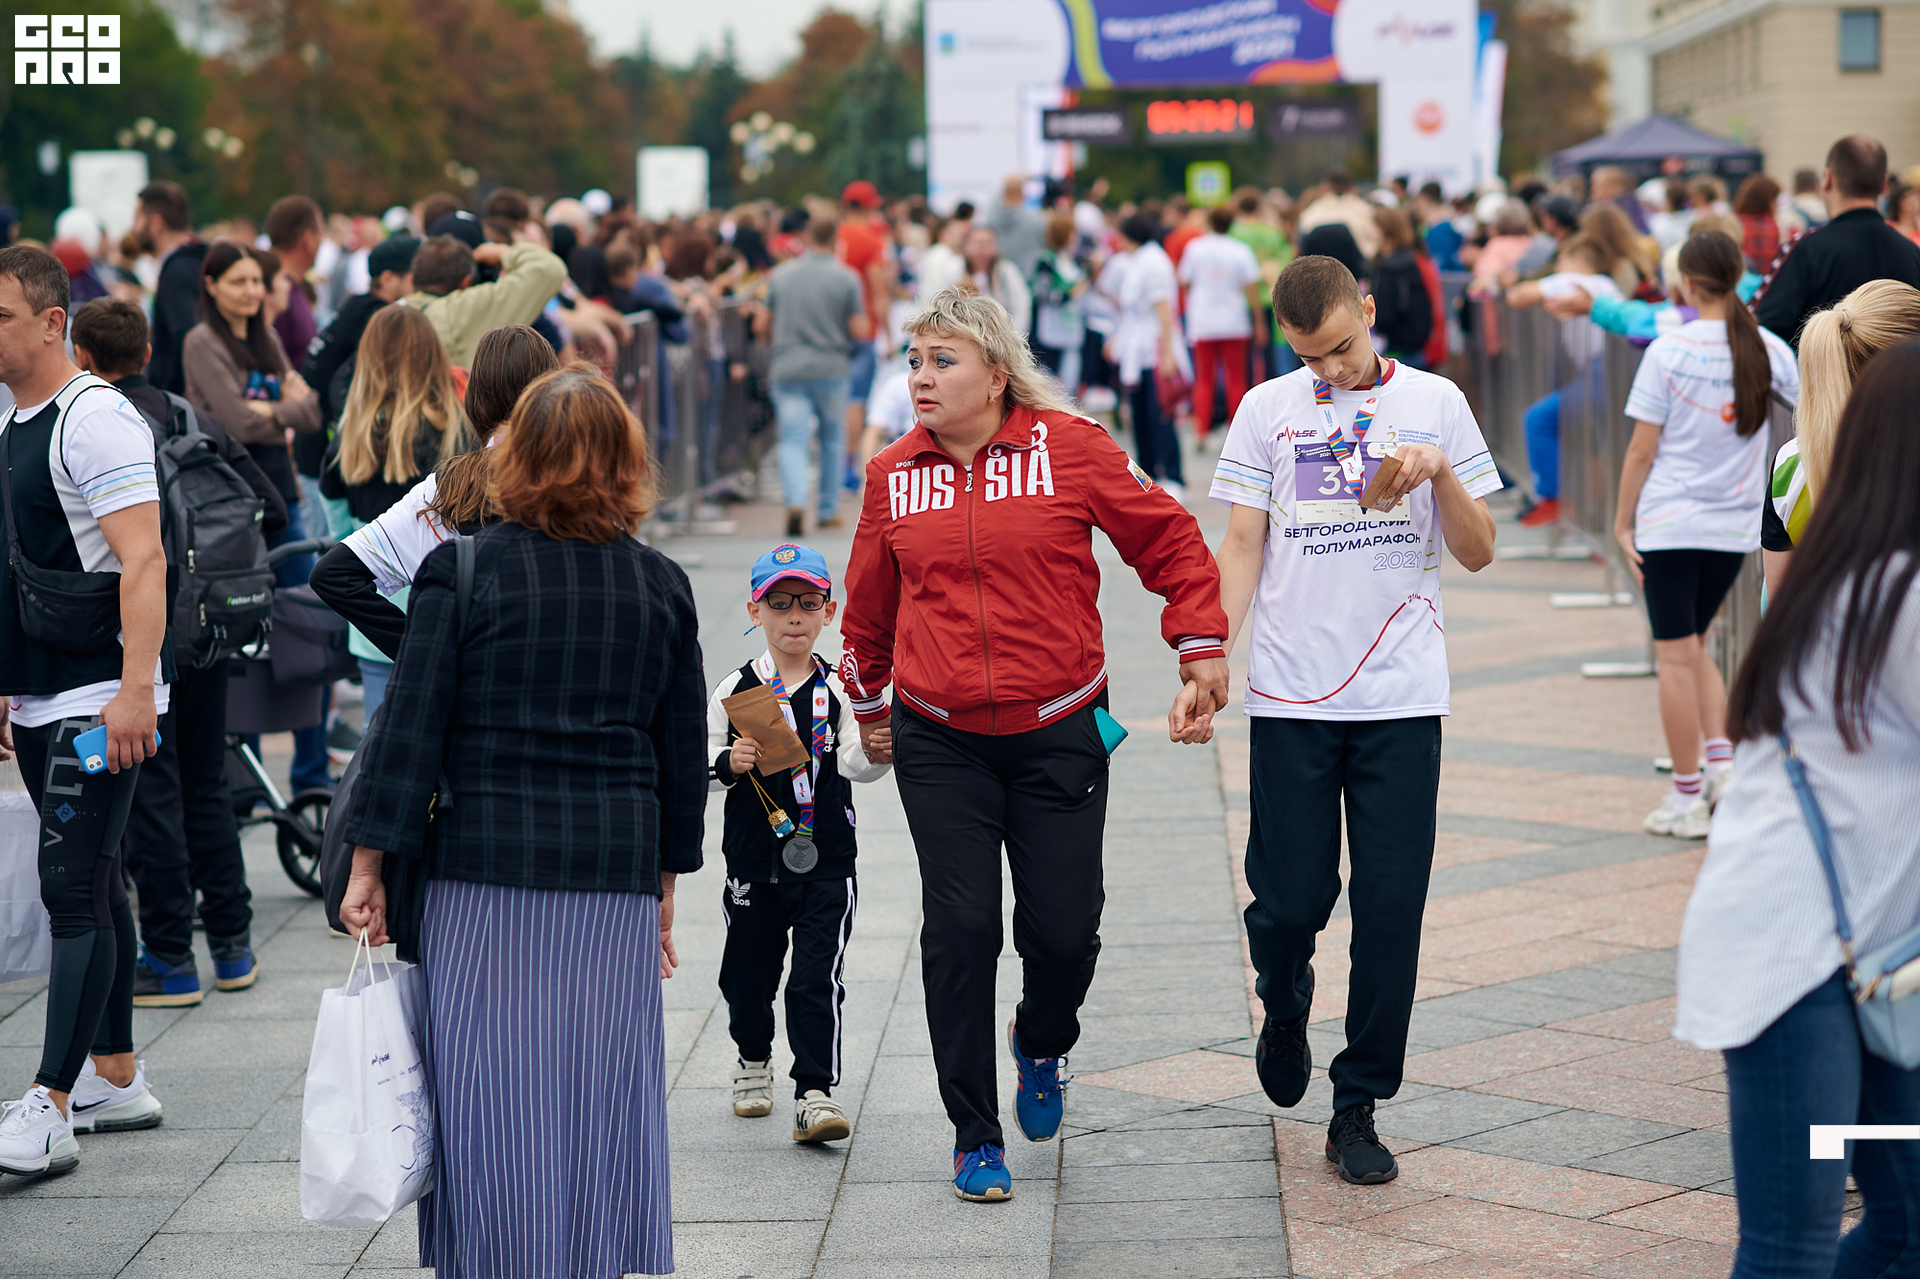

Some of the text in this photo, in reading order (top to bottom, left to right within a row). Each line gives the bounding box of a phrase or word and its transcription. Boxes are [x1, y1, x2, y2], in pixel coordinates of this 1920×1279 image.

[895, 460, 915, 469] SPORT
[888, 449, 1055, 521] RUS SIA
[1303, 533, 1421, 556] ПОЛУМАРАФОН
[1373, 550, 1422, 571] 2021
